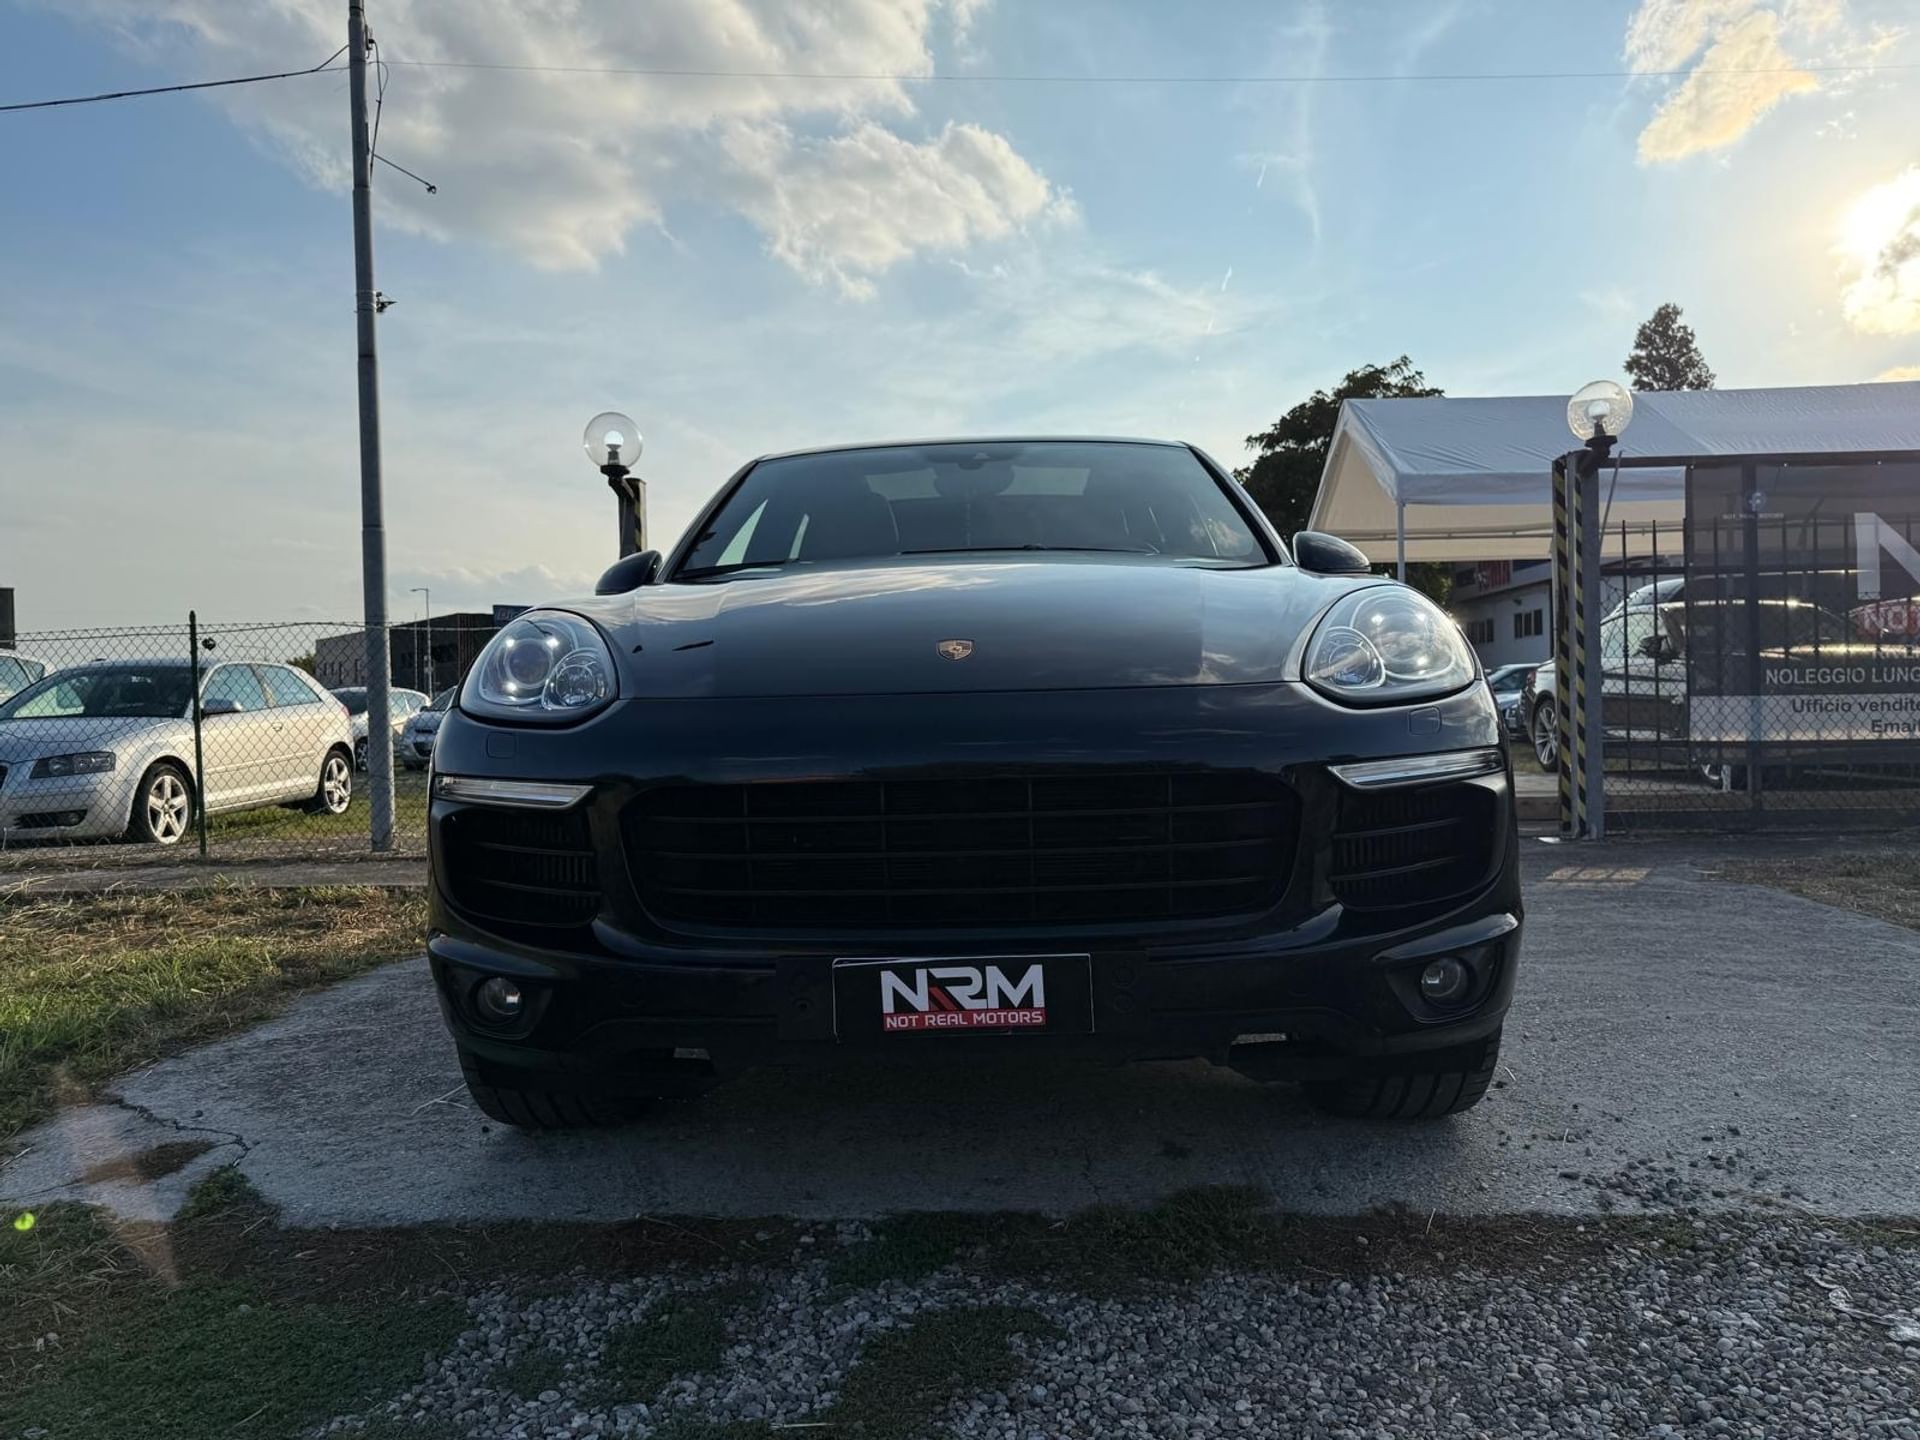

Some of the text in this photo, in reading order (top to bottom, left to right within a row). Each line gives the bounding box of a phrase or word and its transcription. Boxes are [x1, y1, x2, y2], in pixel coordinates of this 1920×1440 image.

[1765, 667, 1866, 685] NOLEGGIO
[1792, 698, 1852, 713] Ufficio
[880, 964, 1046, 1014] NRM
[886, 1011, 1043, 1029] NOT REAL MOTORS
